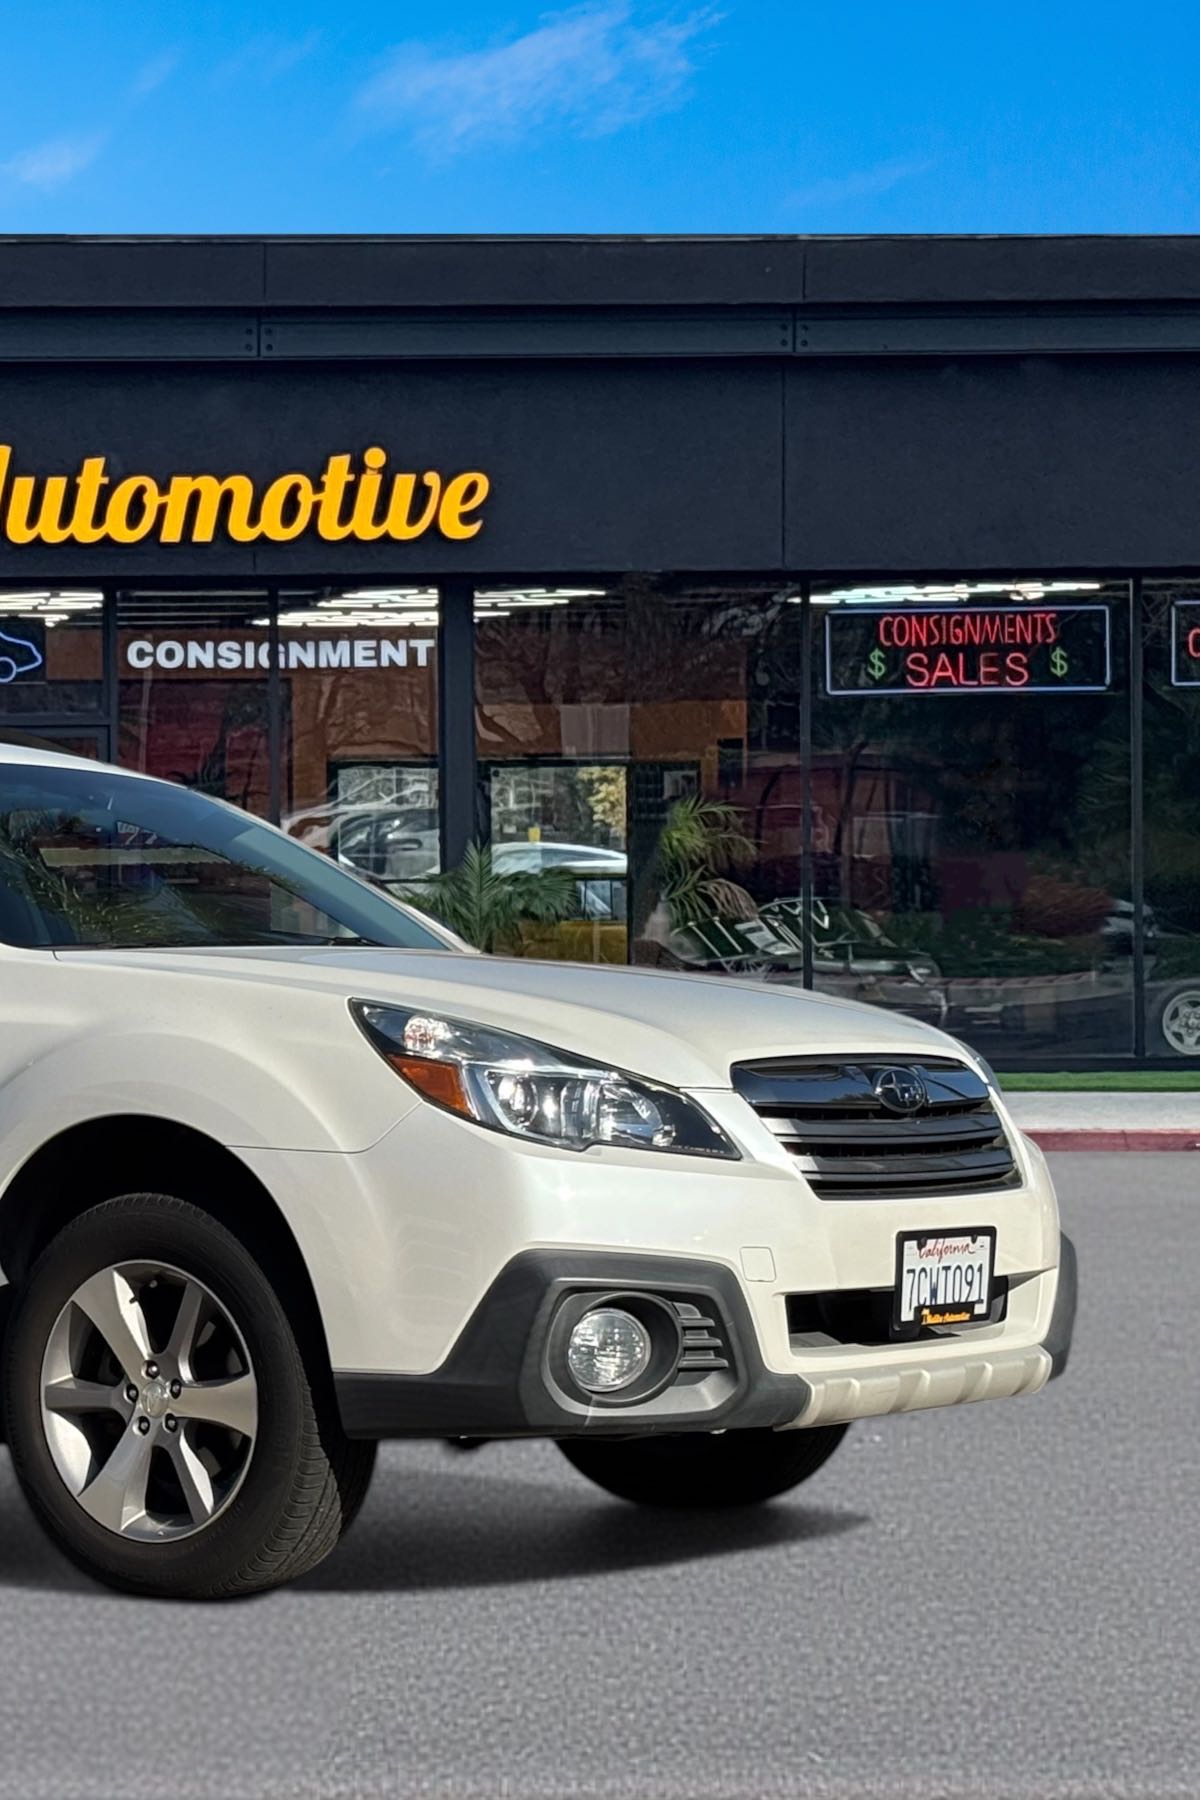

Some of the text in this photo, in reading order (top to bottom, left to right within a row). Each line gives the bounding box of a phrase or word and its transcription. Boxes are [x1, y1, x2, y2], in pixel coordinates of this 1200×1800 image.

[879, 613, 1057, 646] CONSIGNMENTS
[127, 638, 436, 669] CONSIGNMENT
[905, 652, 1029, 687] SALES
[906, 1263, 985, 1312] 7CWT091
